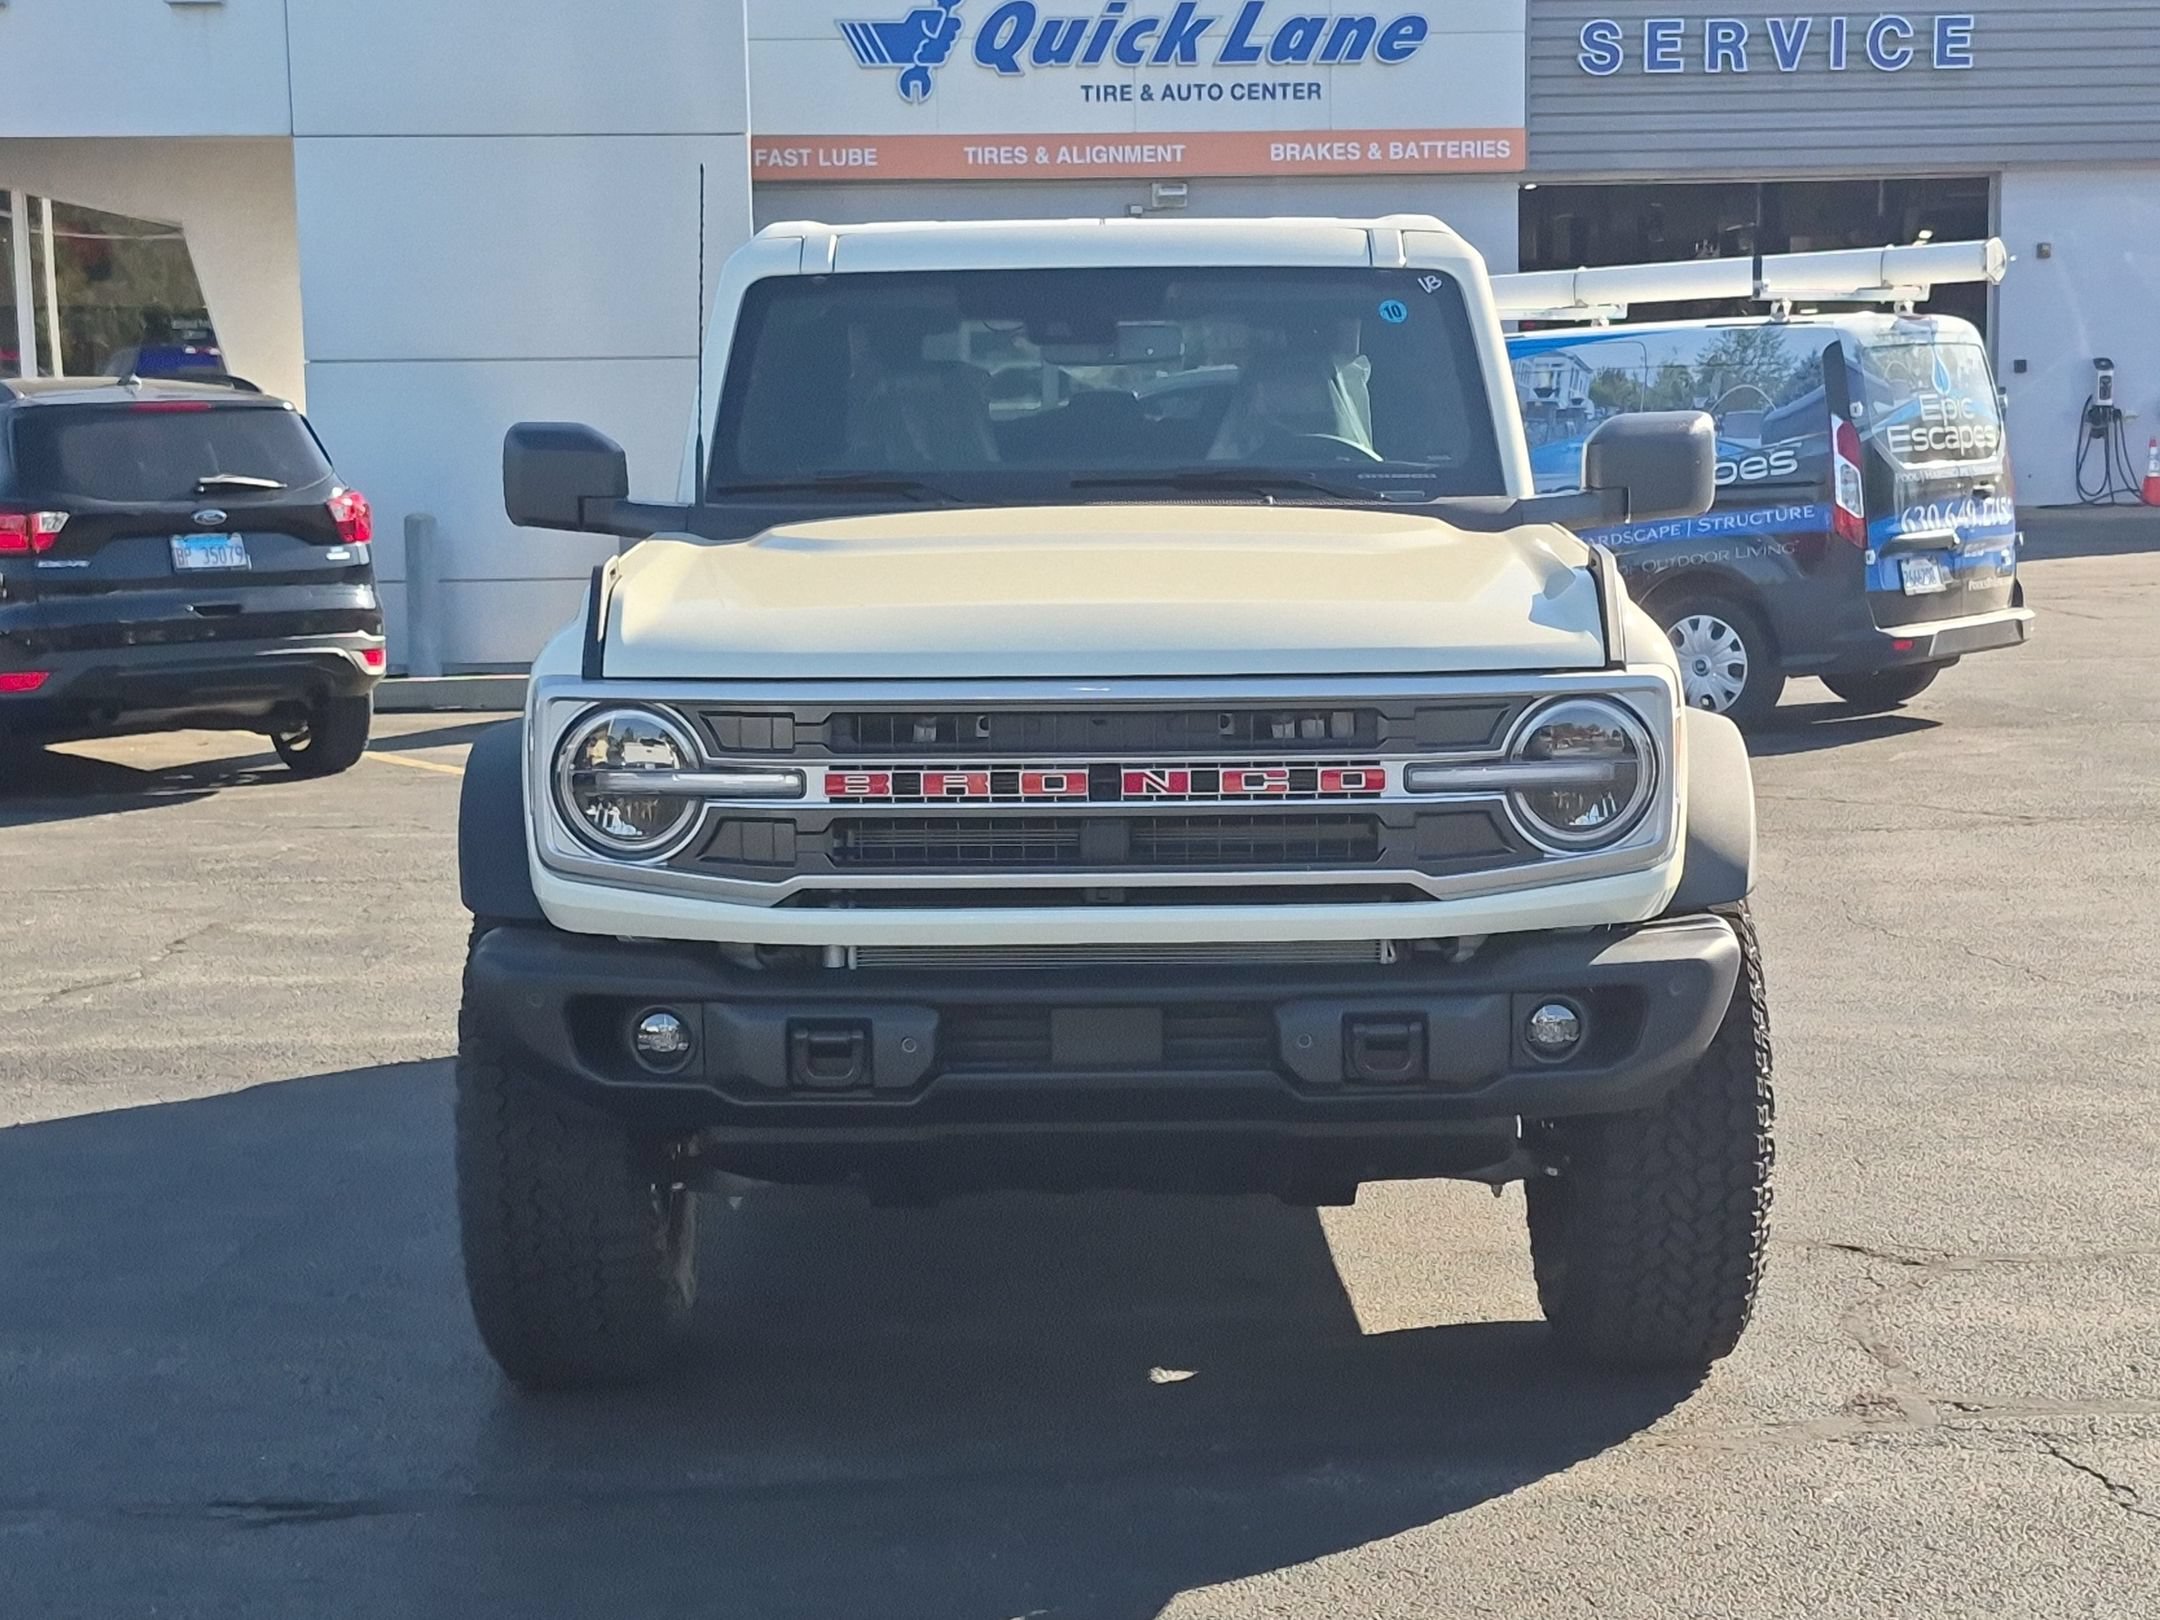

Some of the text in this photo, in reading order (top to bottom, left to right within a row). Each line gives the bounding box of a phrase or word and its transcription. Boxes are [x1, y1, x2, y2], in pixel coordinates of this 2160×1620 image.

[973, 0, 1430, 76] Quick Lane
[1578, 15, 1975, 76] SERVICE
[1081, 82, 1322, 102] TIRE & AUTO CENTER
[754, 148, 878, 167] FAST LUBE
[964, 144, 1186, 165] TIRES & ALIGNMENT
[1270, 140, 1511, 161] BRAKES & BATTERIES
[1383, 304, 1403, 320] 10
[1919, 393, 1975, 427] Epic
[1886, 424, 1996, 457] Escapes
[1584, 523, 1681, 546] ARDSCAPE
[1697, 504, 1816, 533] STRUCTURE
[1735, 542, 1795, 561] LIVING
[823, 767, 1387, 798] BRONCO
